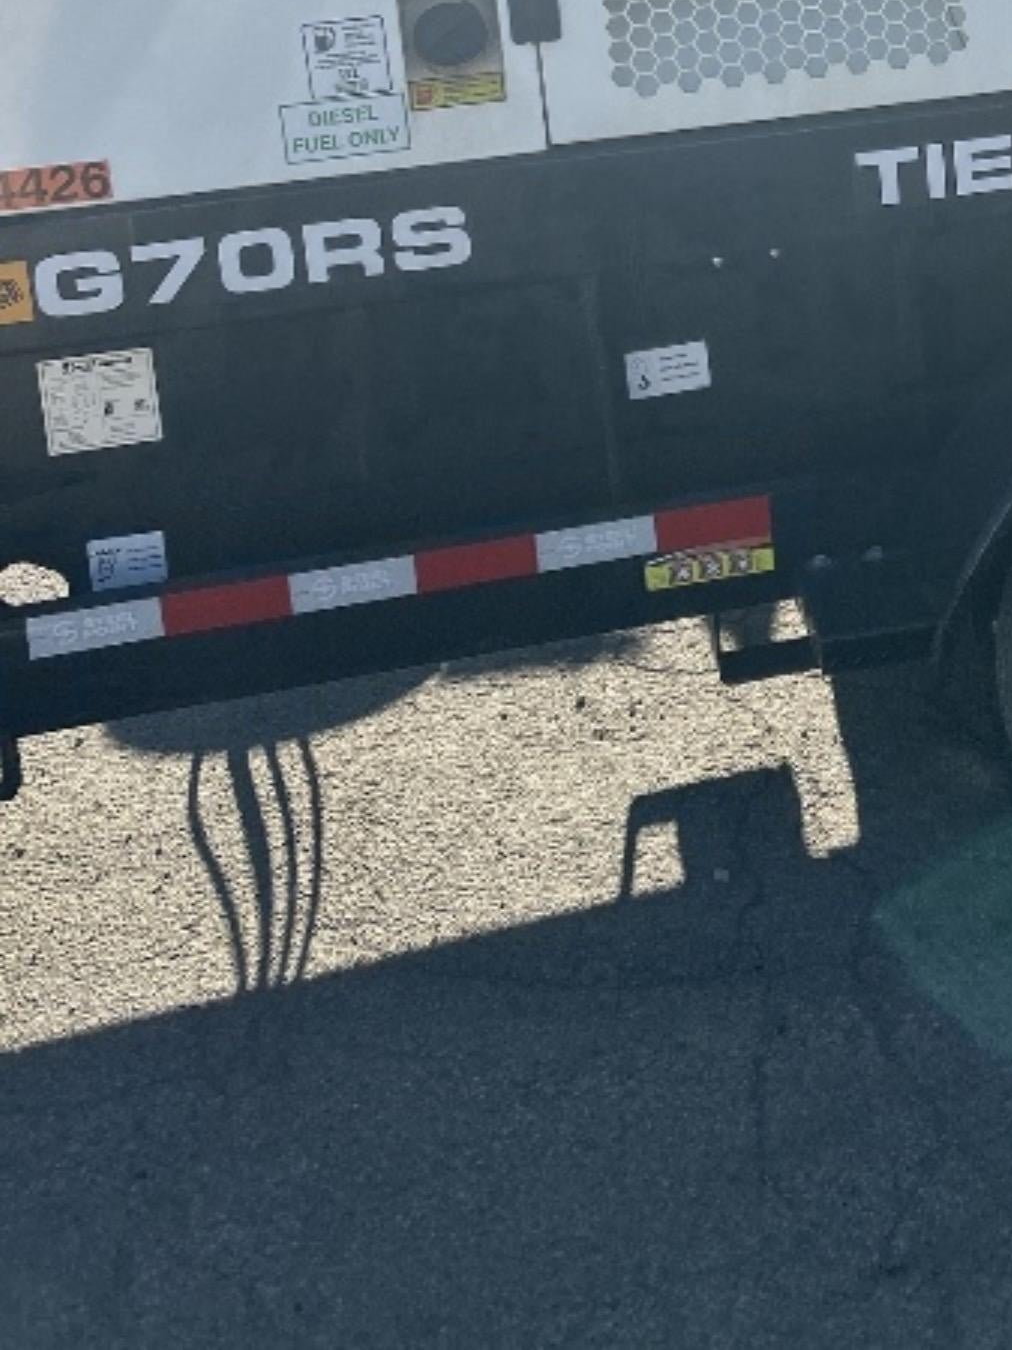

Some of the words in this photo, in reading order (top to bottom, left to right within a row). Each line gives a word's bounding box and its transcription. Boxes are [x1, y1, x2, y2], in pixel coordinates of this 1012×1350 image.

[307, 104, 379, 127] DIESEL
[292, 134, 338, 154] FUEL
[350, 126, 400, 146] ONLY
